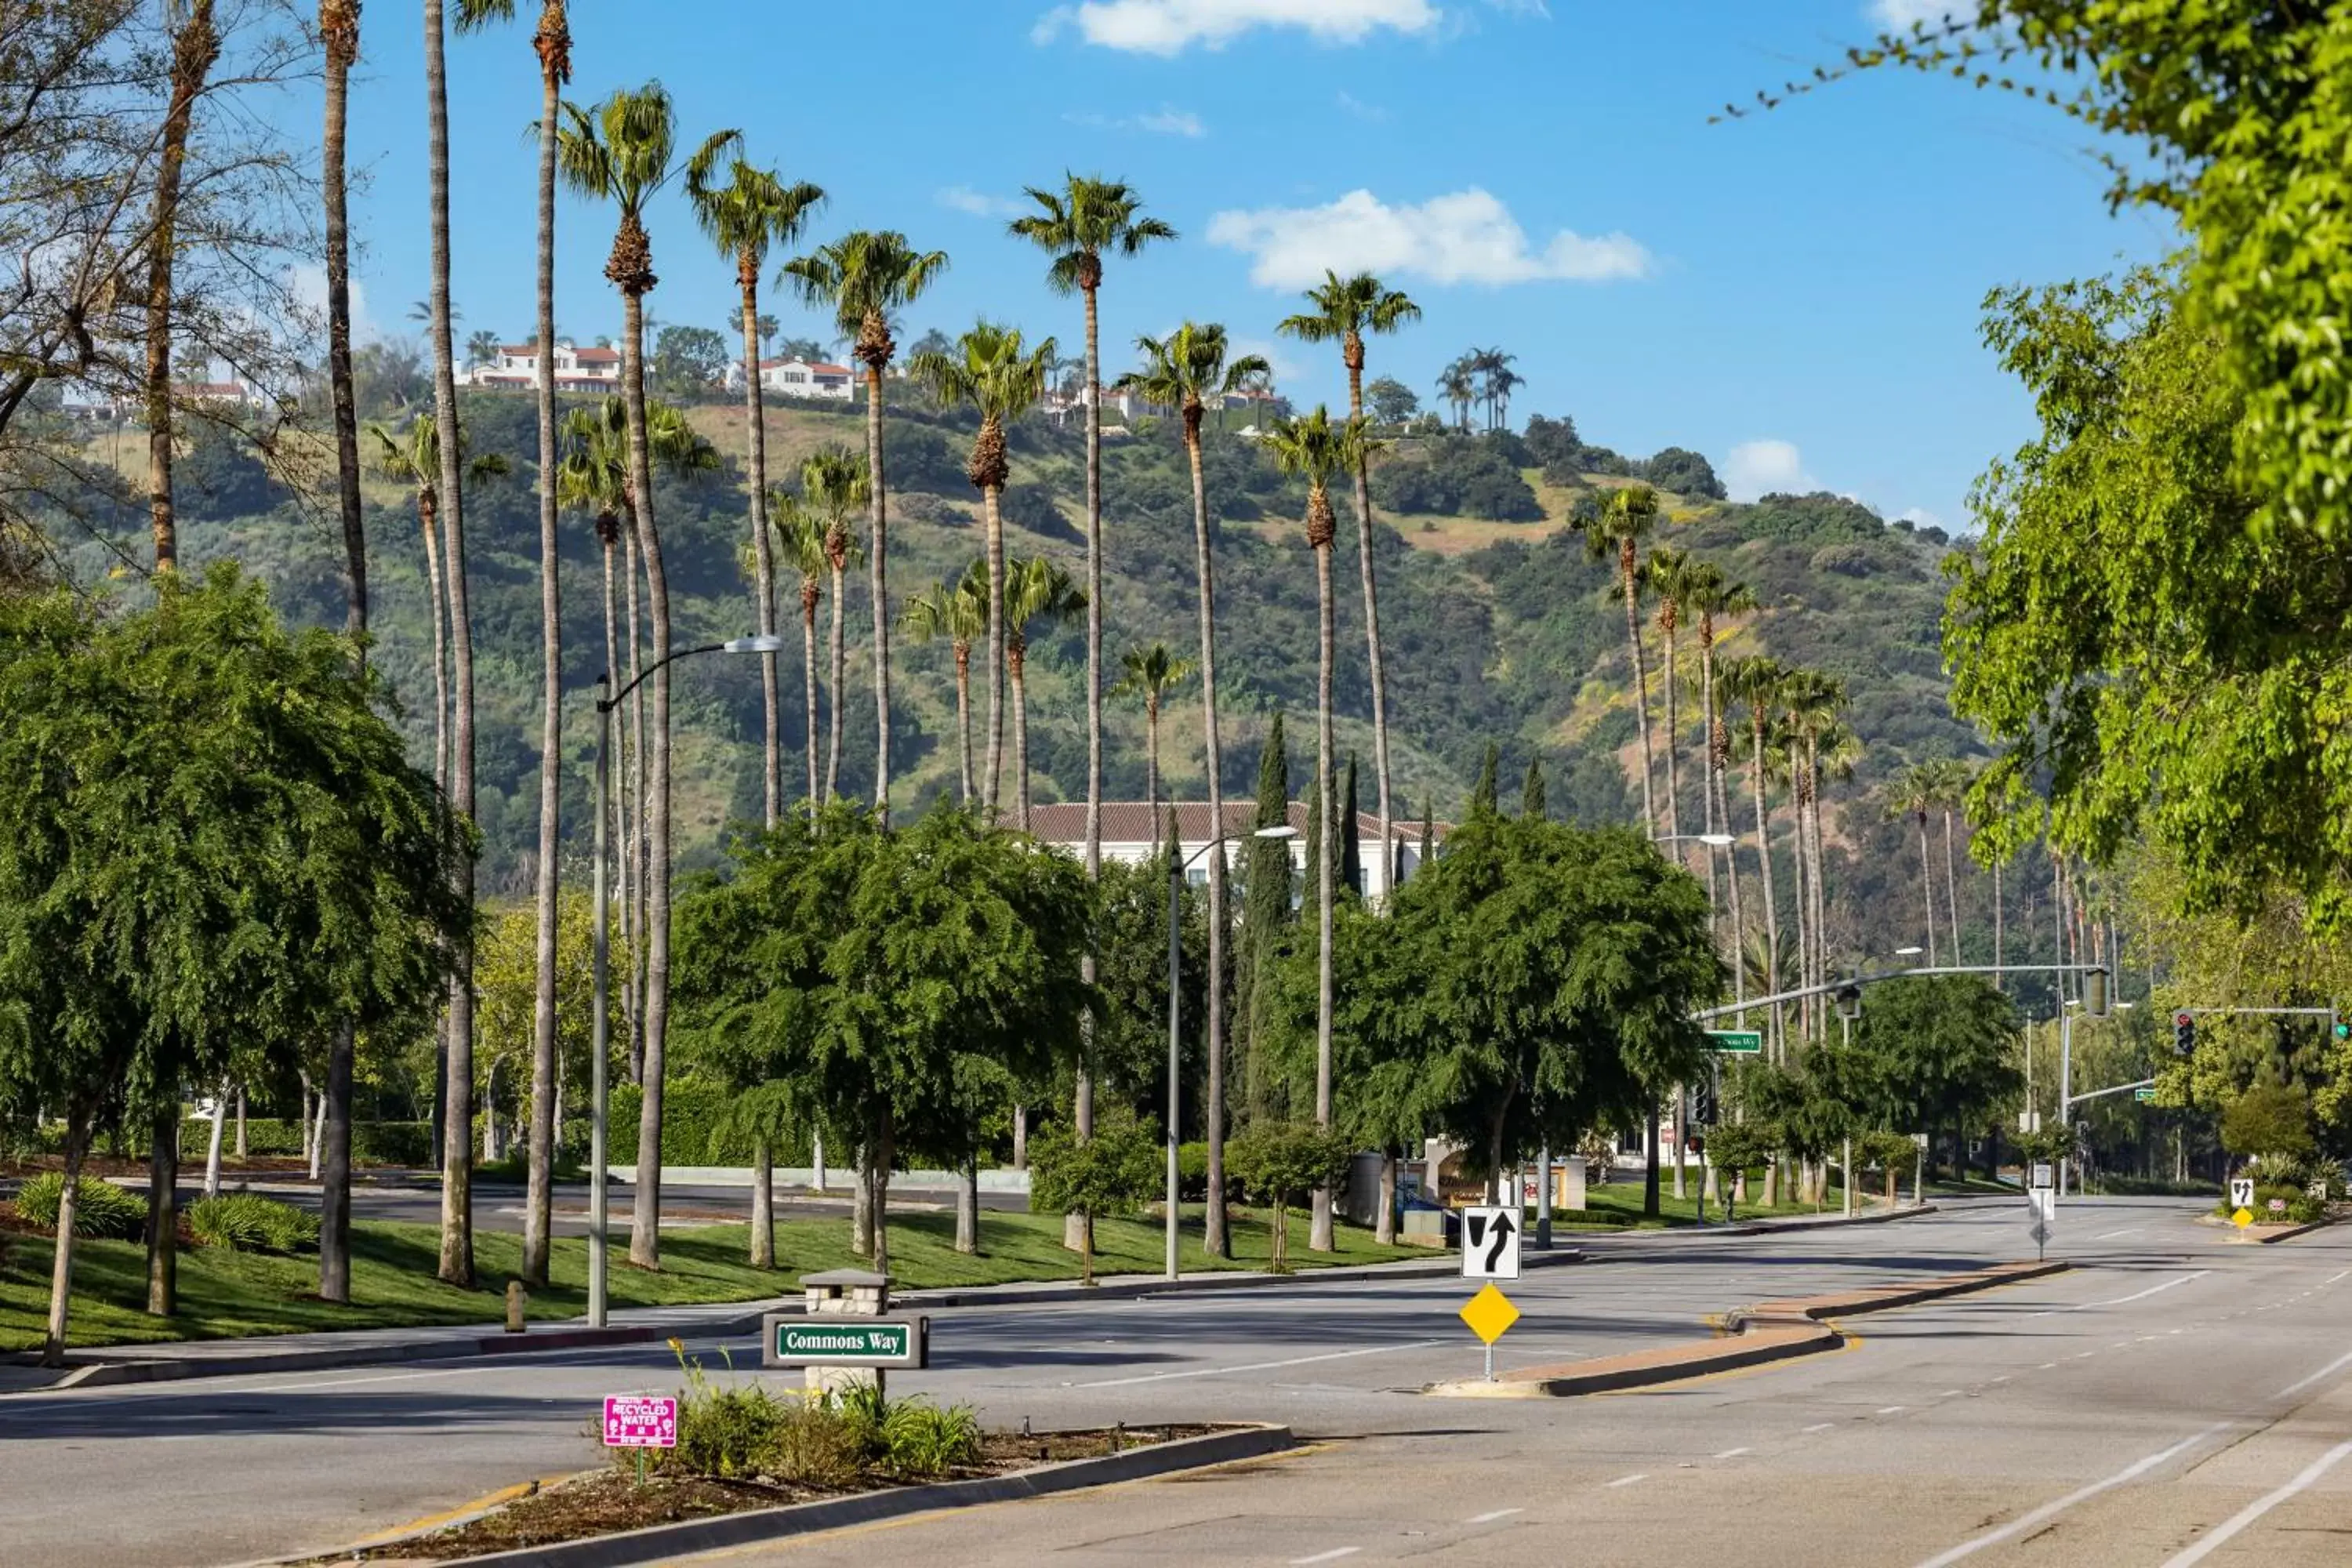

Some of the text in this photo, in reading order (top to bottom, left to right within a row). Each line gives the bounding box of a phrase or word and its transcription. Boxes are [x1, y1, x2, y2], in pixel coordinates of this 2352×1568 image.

[786, 1332, 899, 1354] Commons Way
[612, 1404, 669, 1416] RECYCLED
[621, 1415, 658, 1425] WATER
